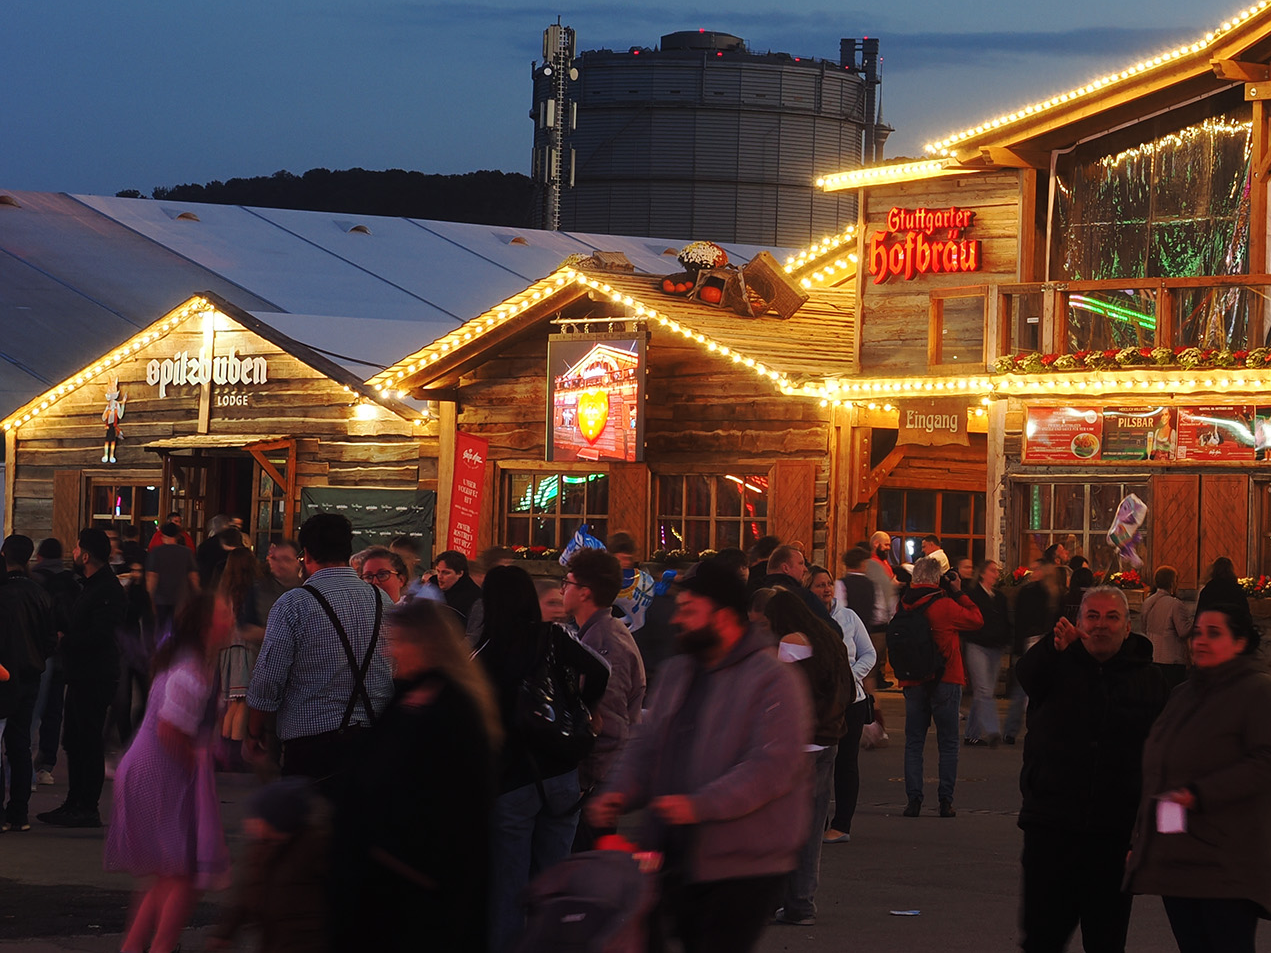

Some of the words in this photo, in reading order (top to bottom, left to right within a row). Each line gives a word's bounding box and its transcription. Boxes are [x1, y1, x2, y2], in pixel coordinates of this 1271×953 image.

[887, 206, 972, 233] Stuttgarter
[869, 230, 979, 284] Hofbräu
[146, 347, 268, 399] spitzbuben
[217, 395, 248, 406] LODGE
[906, 410, 958, 432] Eingang
[1118, 417, 1154, 428] PILSBAR
